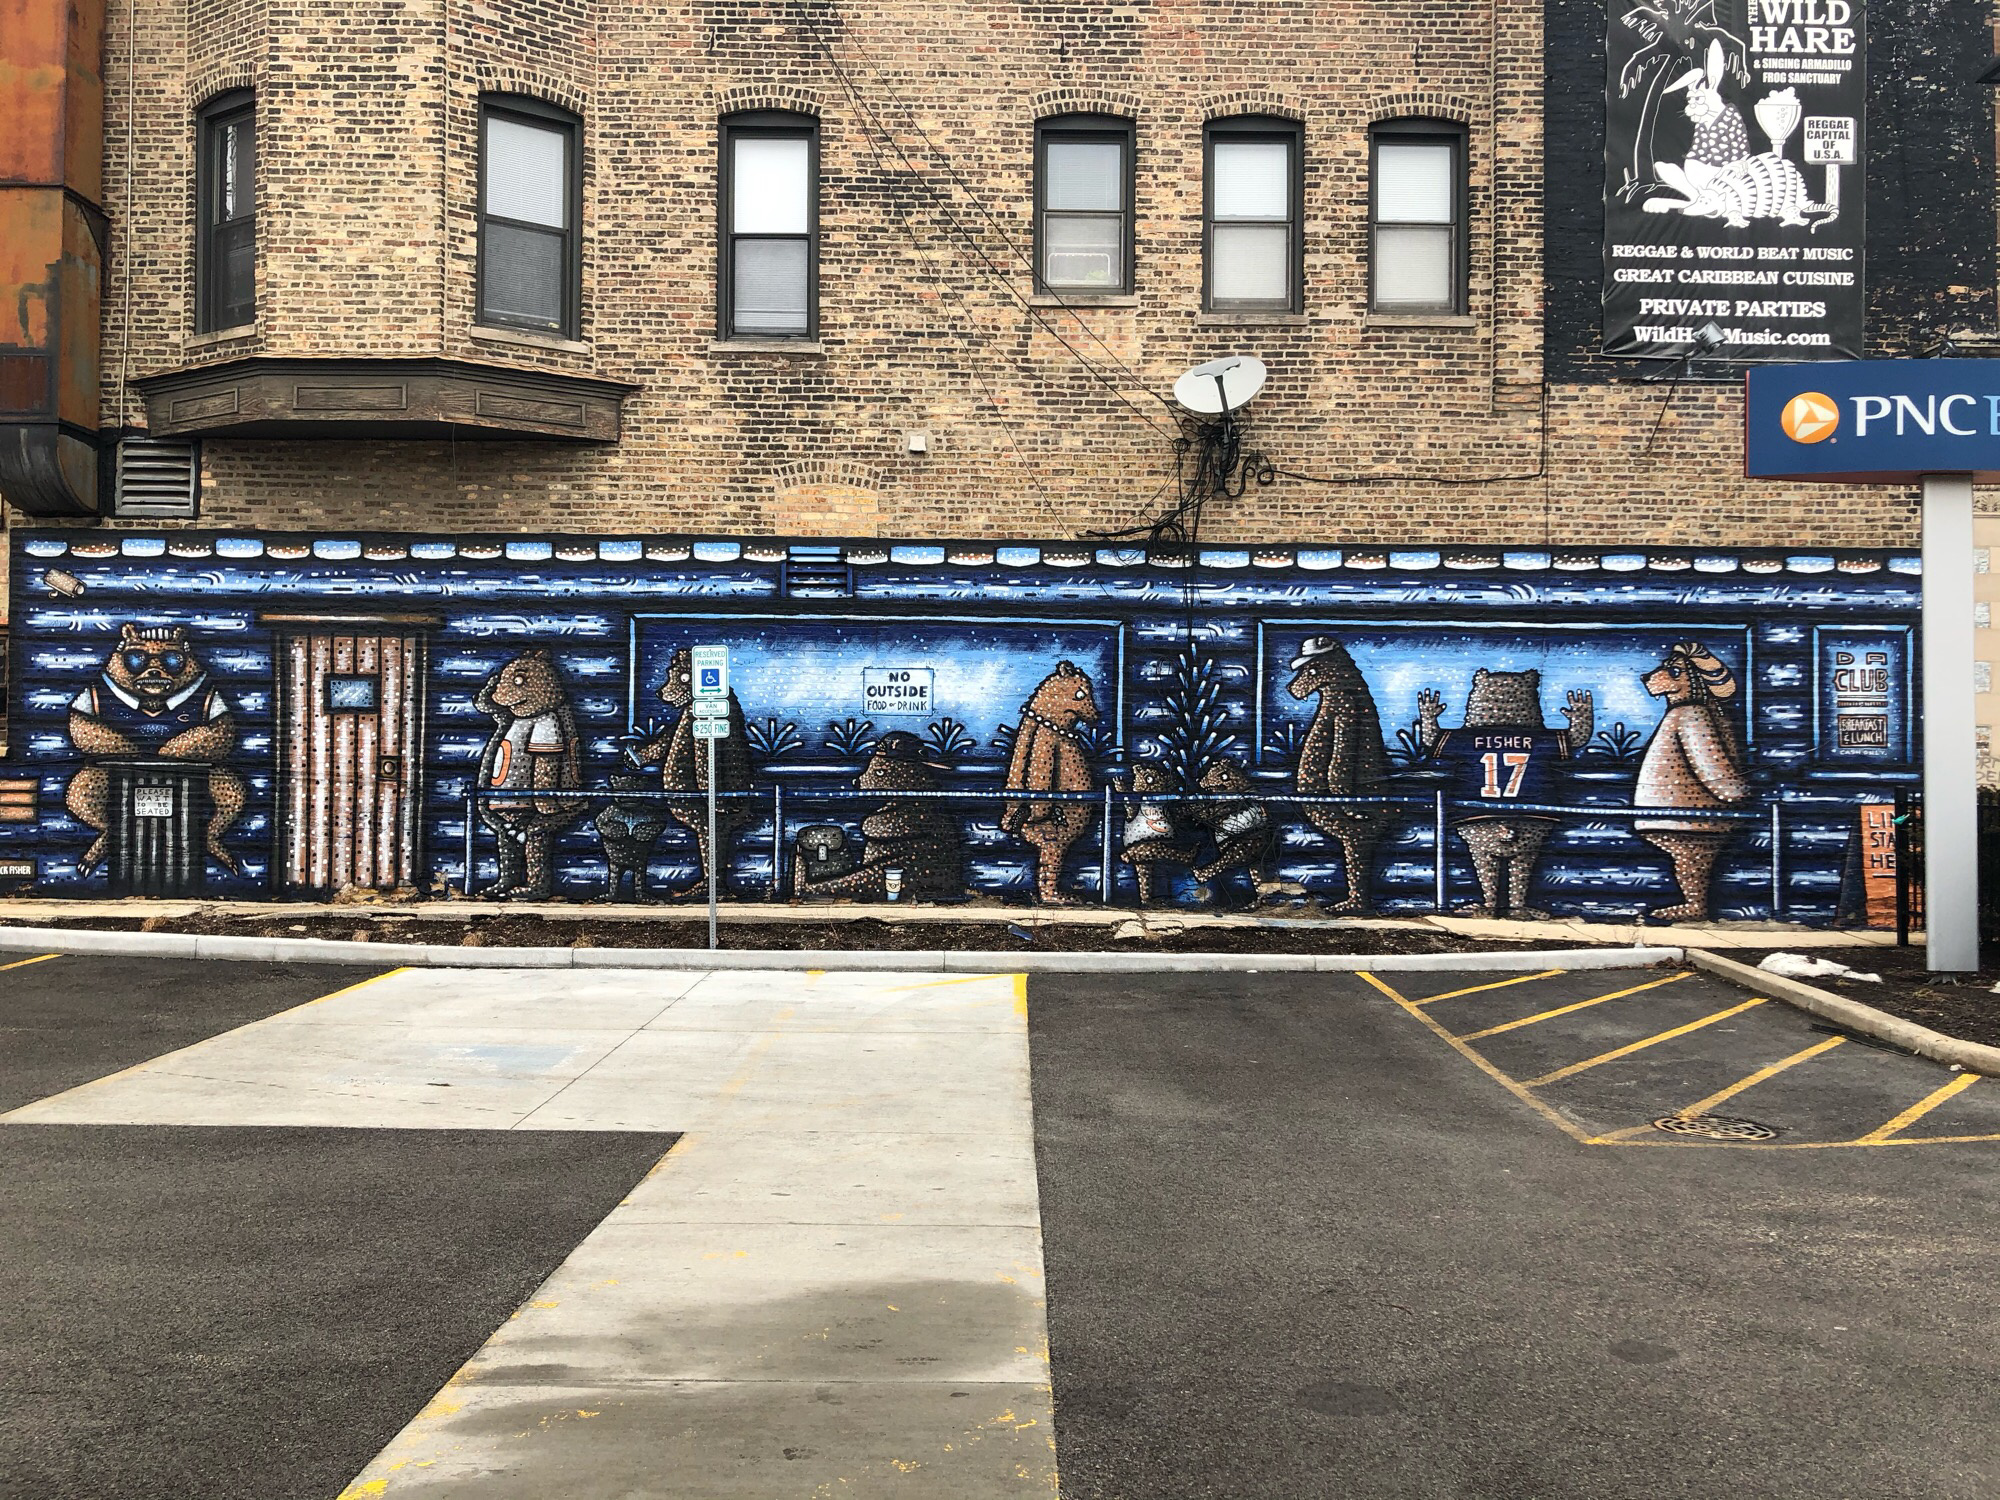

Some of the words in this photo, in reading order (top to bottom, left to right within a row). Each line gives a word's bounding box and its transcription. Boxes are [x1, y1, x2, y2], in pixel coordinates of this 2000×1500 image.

[1759, 0, 1850, 25] WILD
[1749, 26, 1856, 54] HARE
[1753, 60, 1761, 69] &
[1762, 58, 1800, 70] SINGING
[1801, 59, 1852, 70] ARMADILLO
[1762, 72, 1786, 83] FROG
[1788, 73, 1841, 84] SANCTUARY
[1808, 120, 1849, 129] REGGAE
[1806, 130, 1851, 140] CAPITAL
[1822, 140, 1836, 149] OF
[1813, 150, 1844, 160] U.S.A.
[1612, 245, 1677, 258] REGGAE
[1681, 246, 1694, 258] &
[1696, 246, 1754, 260] WORLD
[1757, 247, 1799, 260] BEAT
[1803, 248, 1853, 260] MUSIC
[1613, 269, 1674, 283] GREAT
[1678, 270, 1779, 285] CARIBBEAN
[1783, 271, 1854, 286] CUISINE
[1639, 299, 1730, 316] PRIVATE
[1734, 301, 1826, 318] PARTIES
[1633, 326, 1831, 346] WildHMusic.com
[1849, 394, 1977, 437] PNC
[1836, 651, 1888, 666] DA
[889, 671, 911, 682] NO
[1833, 668, 1889, 693] CLUB
[866, 685, 928, 697] OUTSIDE
[867, 700, 887, 711] FOOD
[897, 700, 927, 712] DRINK
[694, 724, 713, 734] $250
[714, 724, 728, 733] FINE
[1841, 719, 1884, 731] BREAKFAST
[1475, 736, 1532, 749] FISHER
[1850, 732, 1883, 743] LUNCH
[1479, 752, 1531, 798] 17
[9, 865, 31, 875] FISHER
